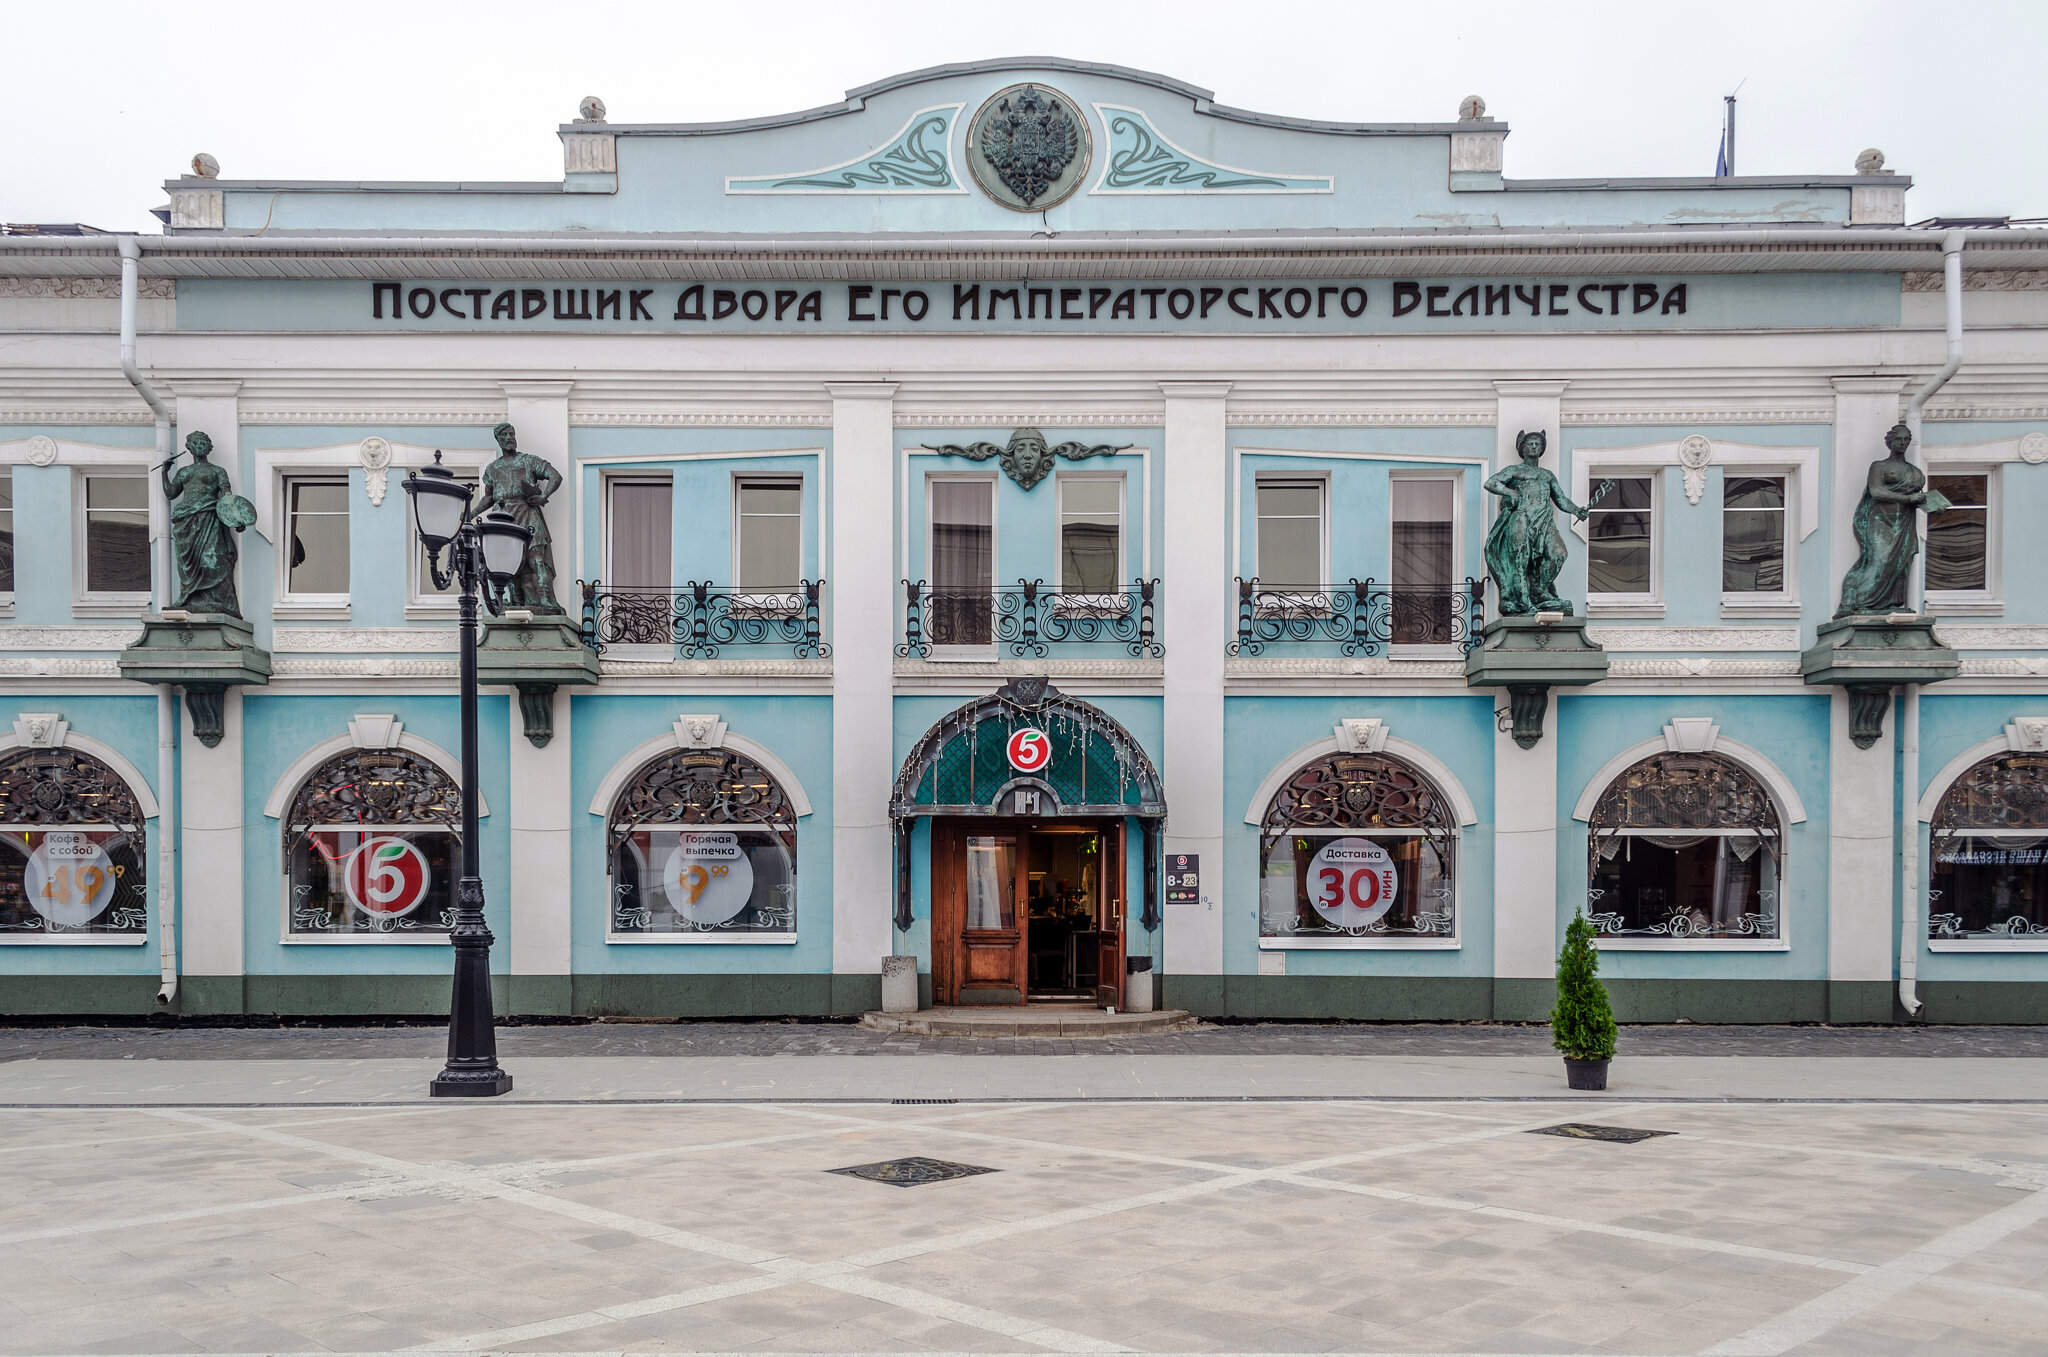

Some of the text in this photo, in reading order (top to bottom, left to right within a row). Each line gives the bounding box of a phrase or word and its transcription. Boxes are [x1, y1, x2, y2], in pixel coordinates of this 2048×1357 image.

[372, 281, 1687, 321] ПОСТАВЩИК ДВОРА ЕГО ИМПЕРАТОРСКОГО ВЕЛИЧЕСТВА
[49, 834, 80, 845] Кофе
[685, 835, 732, 845] Горячая
[49, 846, 94, 855] с собой
[685, 847, 735, 856] выпечка
[1326, 849, 1382, 859] Доставка
[41, 864, 125, 905] 49 99
[679, 865, 729, 905] 9 99
[1319, 867, 1380, 909] 30
